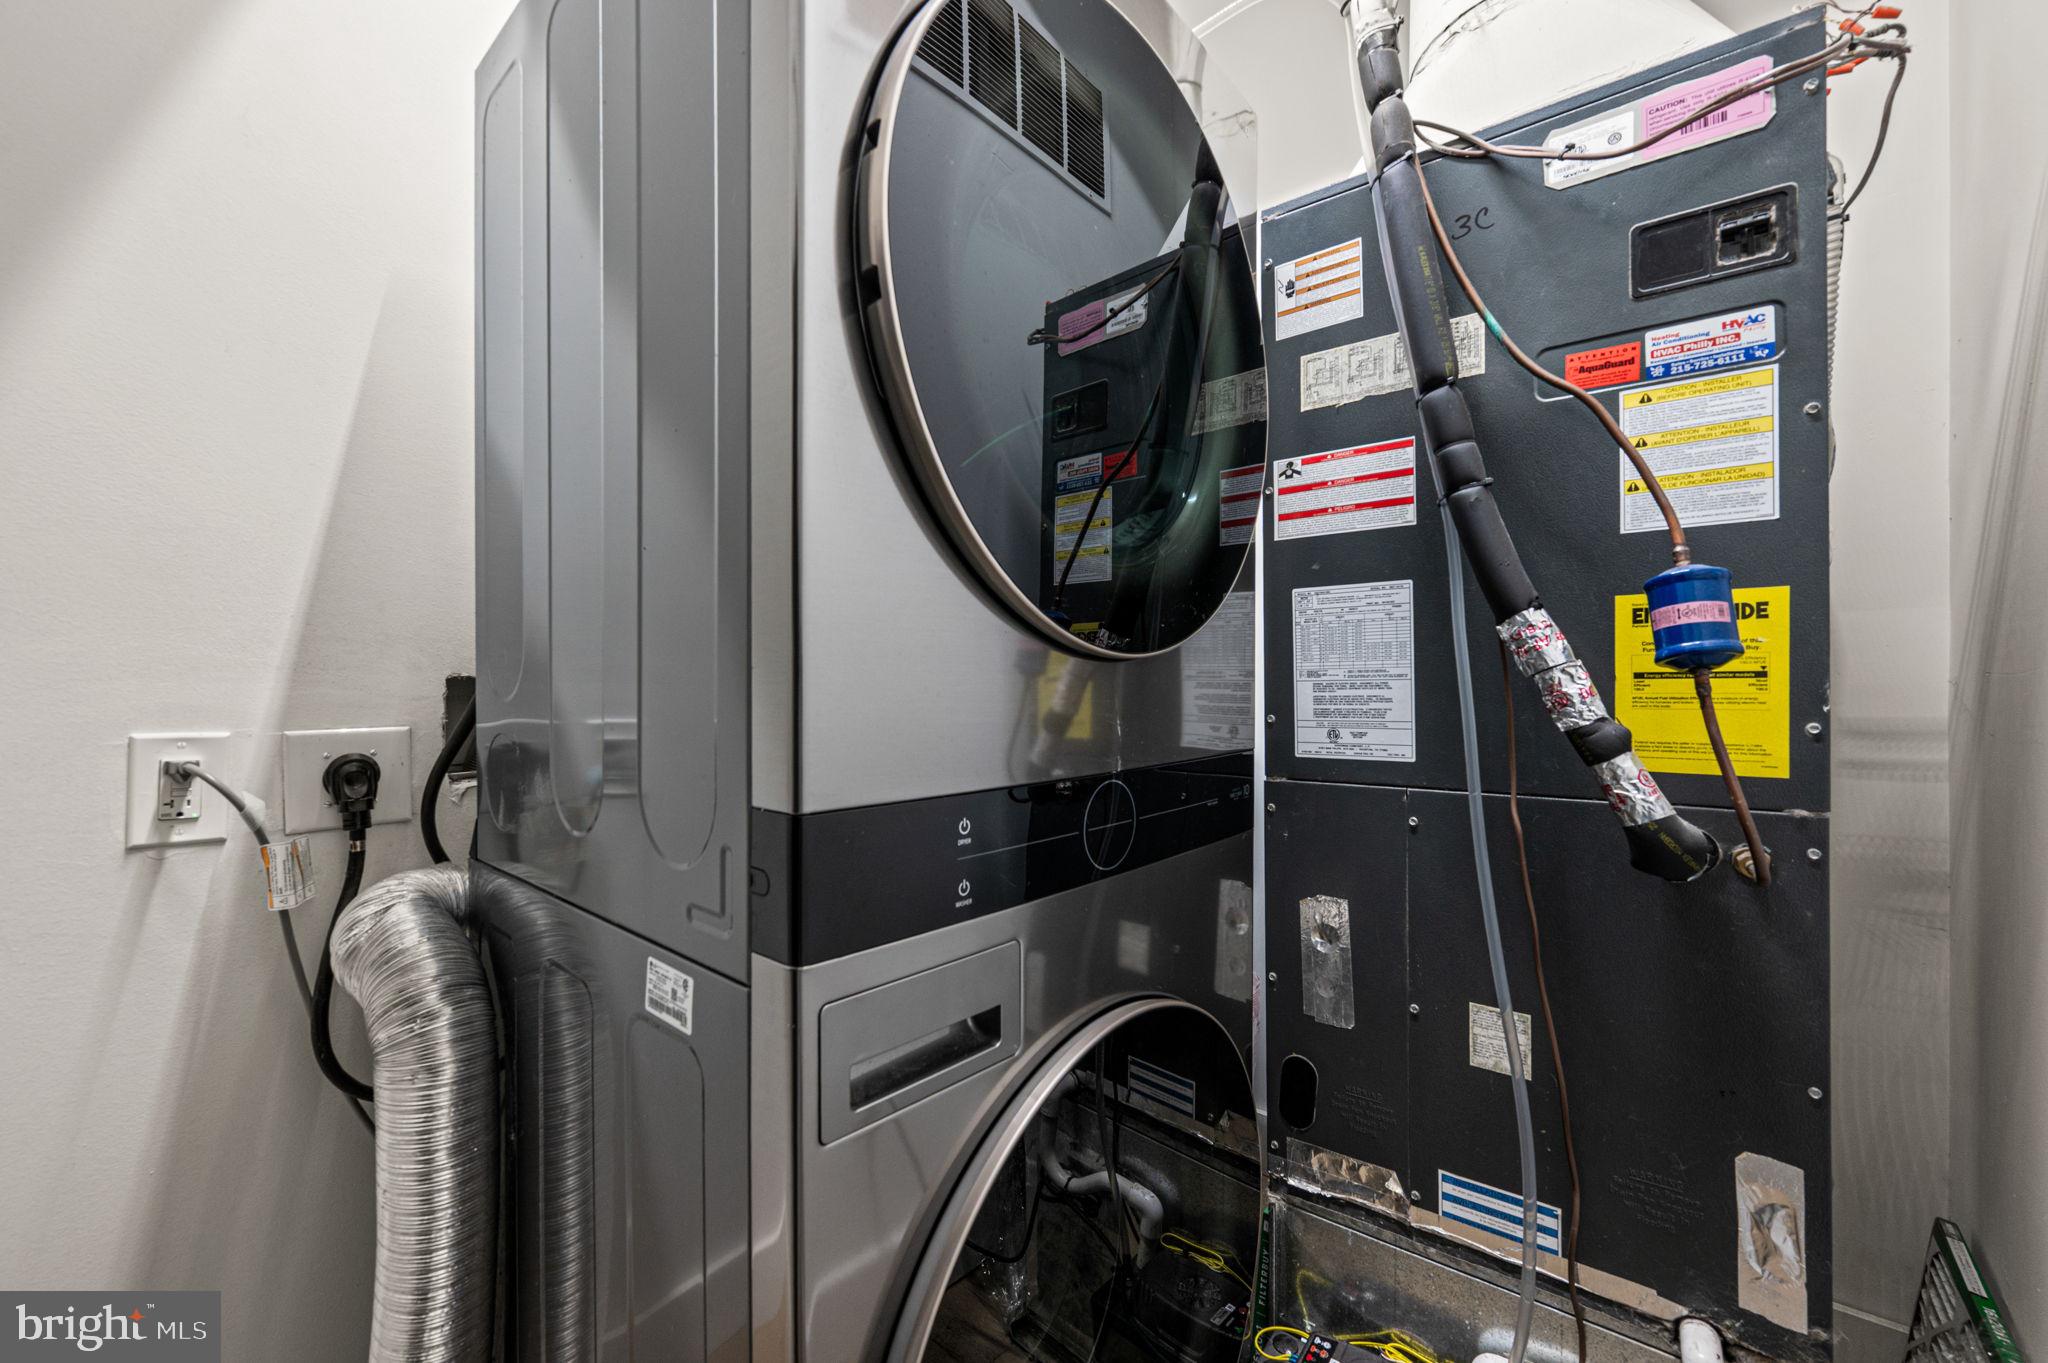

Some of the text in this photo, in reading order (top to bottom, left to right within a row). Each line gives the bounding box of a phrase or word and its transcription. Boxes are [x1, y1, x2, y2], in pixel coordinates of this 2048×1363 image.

[1451, 207, 1495, 240] 3C
[1721, 313, 1766, 330] HVAC
[1651, 331, 1681, 342] Heating
[1651, 331, 1711, 348] Air Conditioning
[1569, 346, 1637, 362] ATTENTION
[1652, 333, 1740, 358] HVAC Philly INC.
[1578, 356, 1635, 374] AquaGuard
[1670, 353, 1746, 375] 215-725-6111
[1665, 375, 1742, 394] CAUTION INSTALLER
[1688, 384, 1731, 397] OPERATING
[1660, 420, 1750, 439] ATTENTION INSTALLEUR
[1679, 476, 1722, 487] FUNCIONAR
[1723, 474, 1734, 482] LA
[1700, 467, 1746, 479] INSTALADOR
[1258, 1249, 1270, 1306] FILTERBUY
